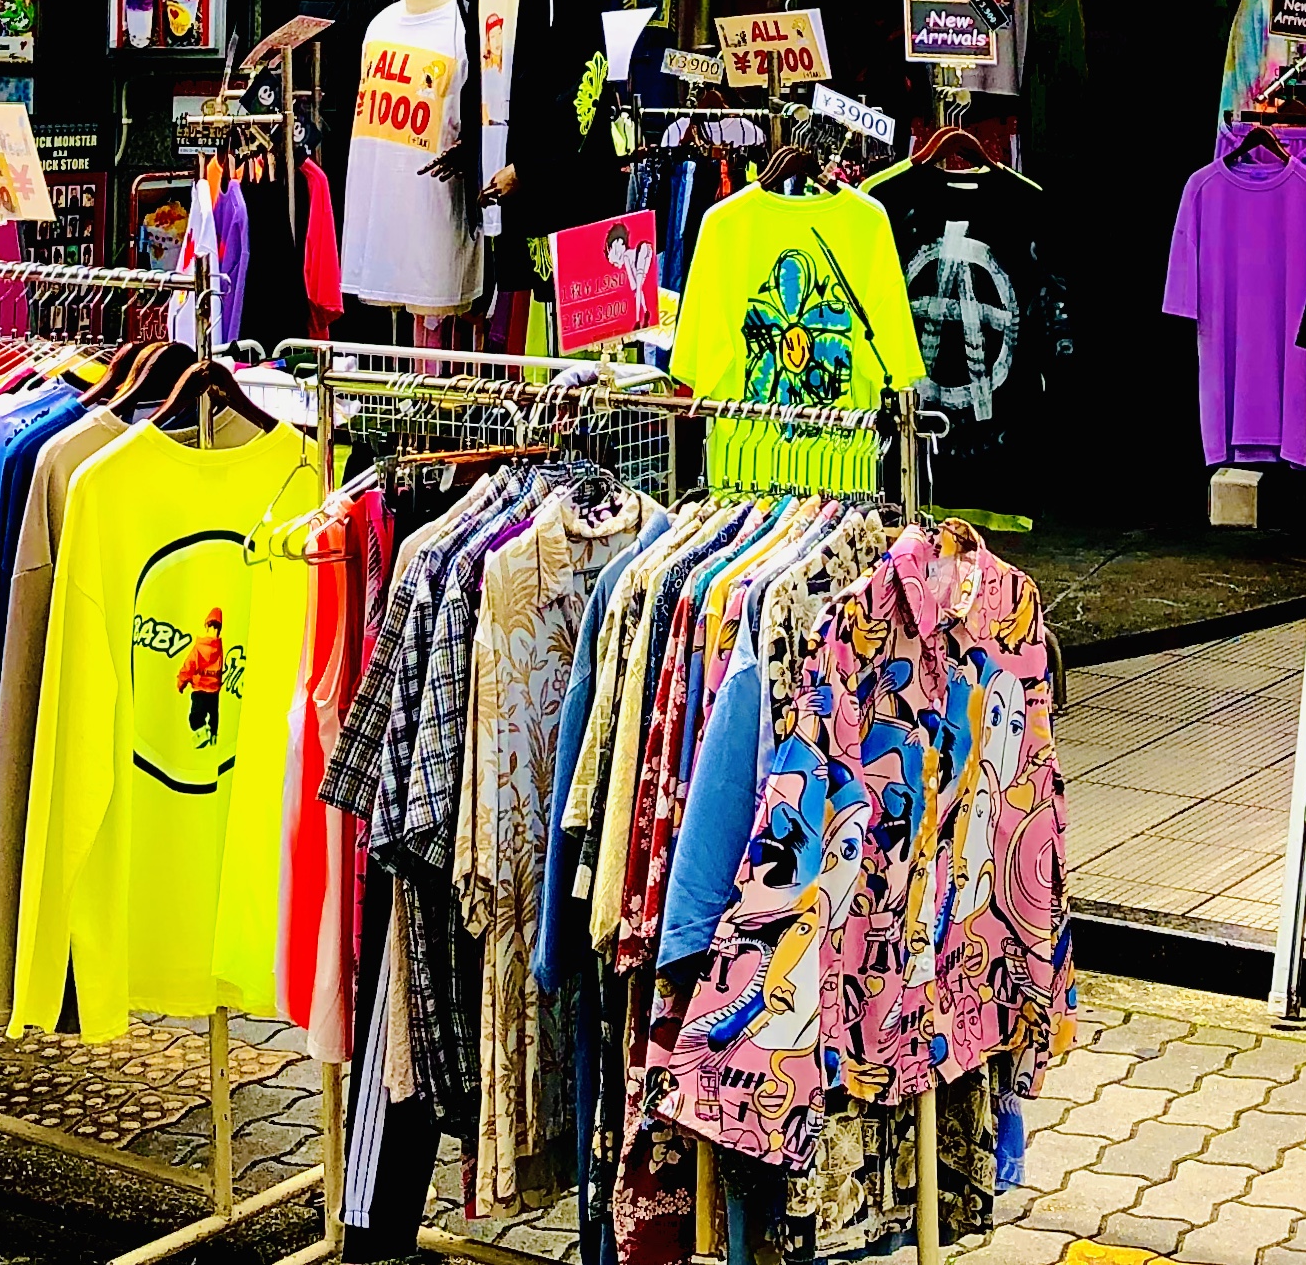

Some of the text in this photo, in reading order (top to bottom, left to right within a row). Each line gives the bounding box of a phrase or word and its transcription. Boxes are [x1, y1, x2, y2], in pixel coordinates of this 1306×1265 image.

[751, 20, 788, 43] ALL
[929, 11, 970, 29] New
[915, 28, 987, 46] Arrivals
[372, 50, 412, 84] ALL
[731, 47, 814, 75] ¥200
[356, 89, 431, 136] ¥1000
[822, 92, 888, 136] ¥3900
[54, 135, 98, 147] MONSTER
[60, 158, 90, 170] STORE
